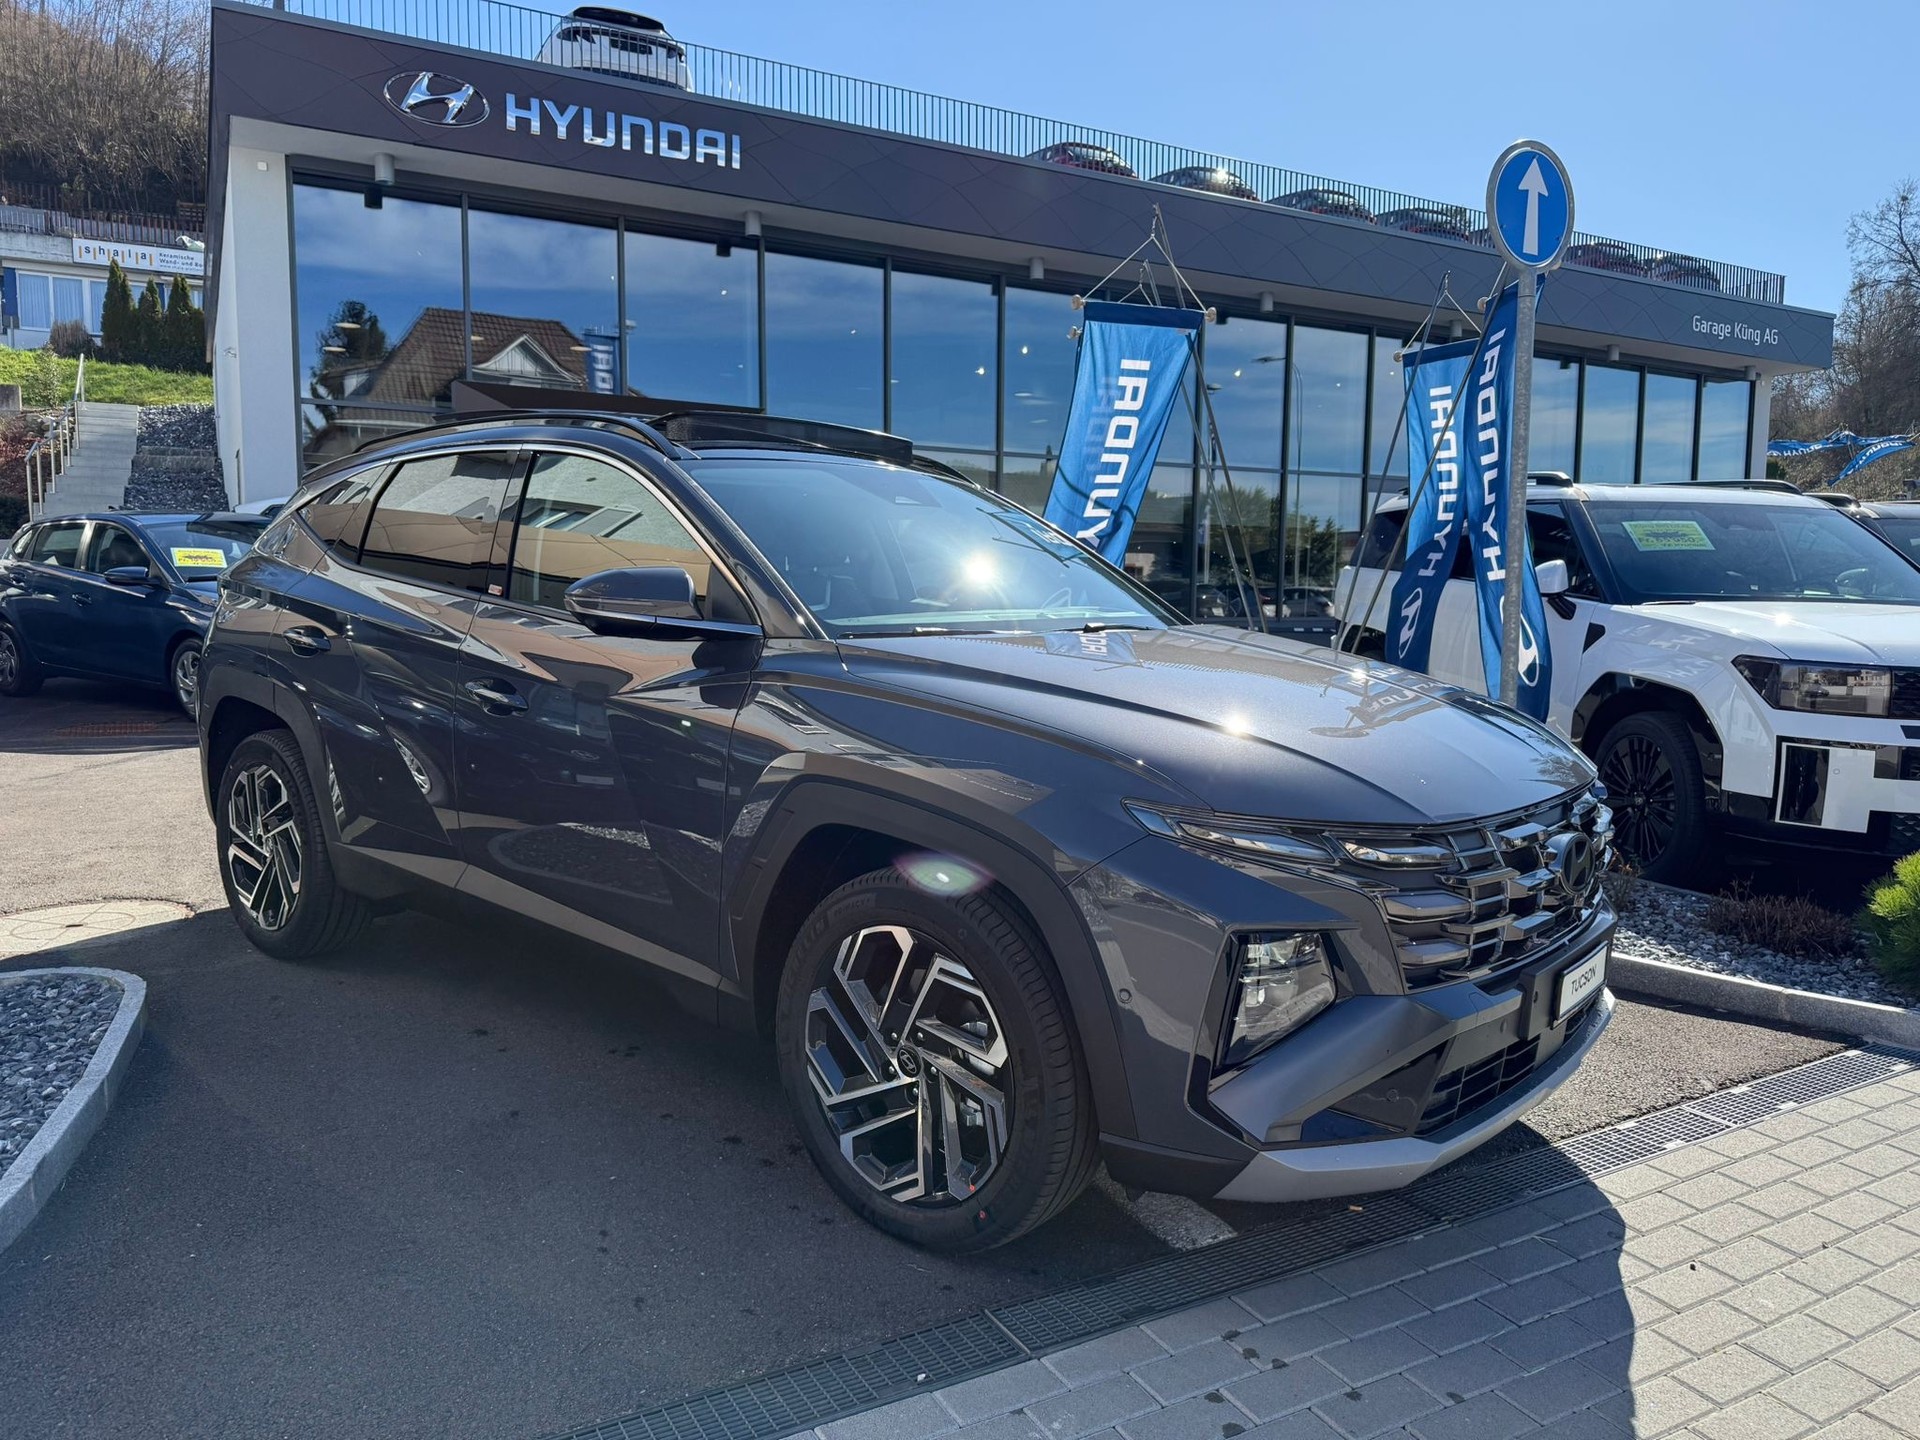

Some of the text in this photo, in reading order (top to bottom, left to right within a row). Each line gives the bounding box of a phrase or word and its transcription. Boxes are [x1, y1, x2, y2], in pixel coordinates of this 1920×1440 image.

[505, 92, 742, 170] HYUNDAI
[1692, 315, 1779, 346] Garage Küng AG
[1570, 963, 1597, 995] TUCSON
